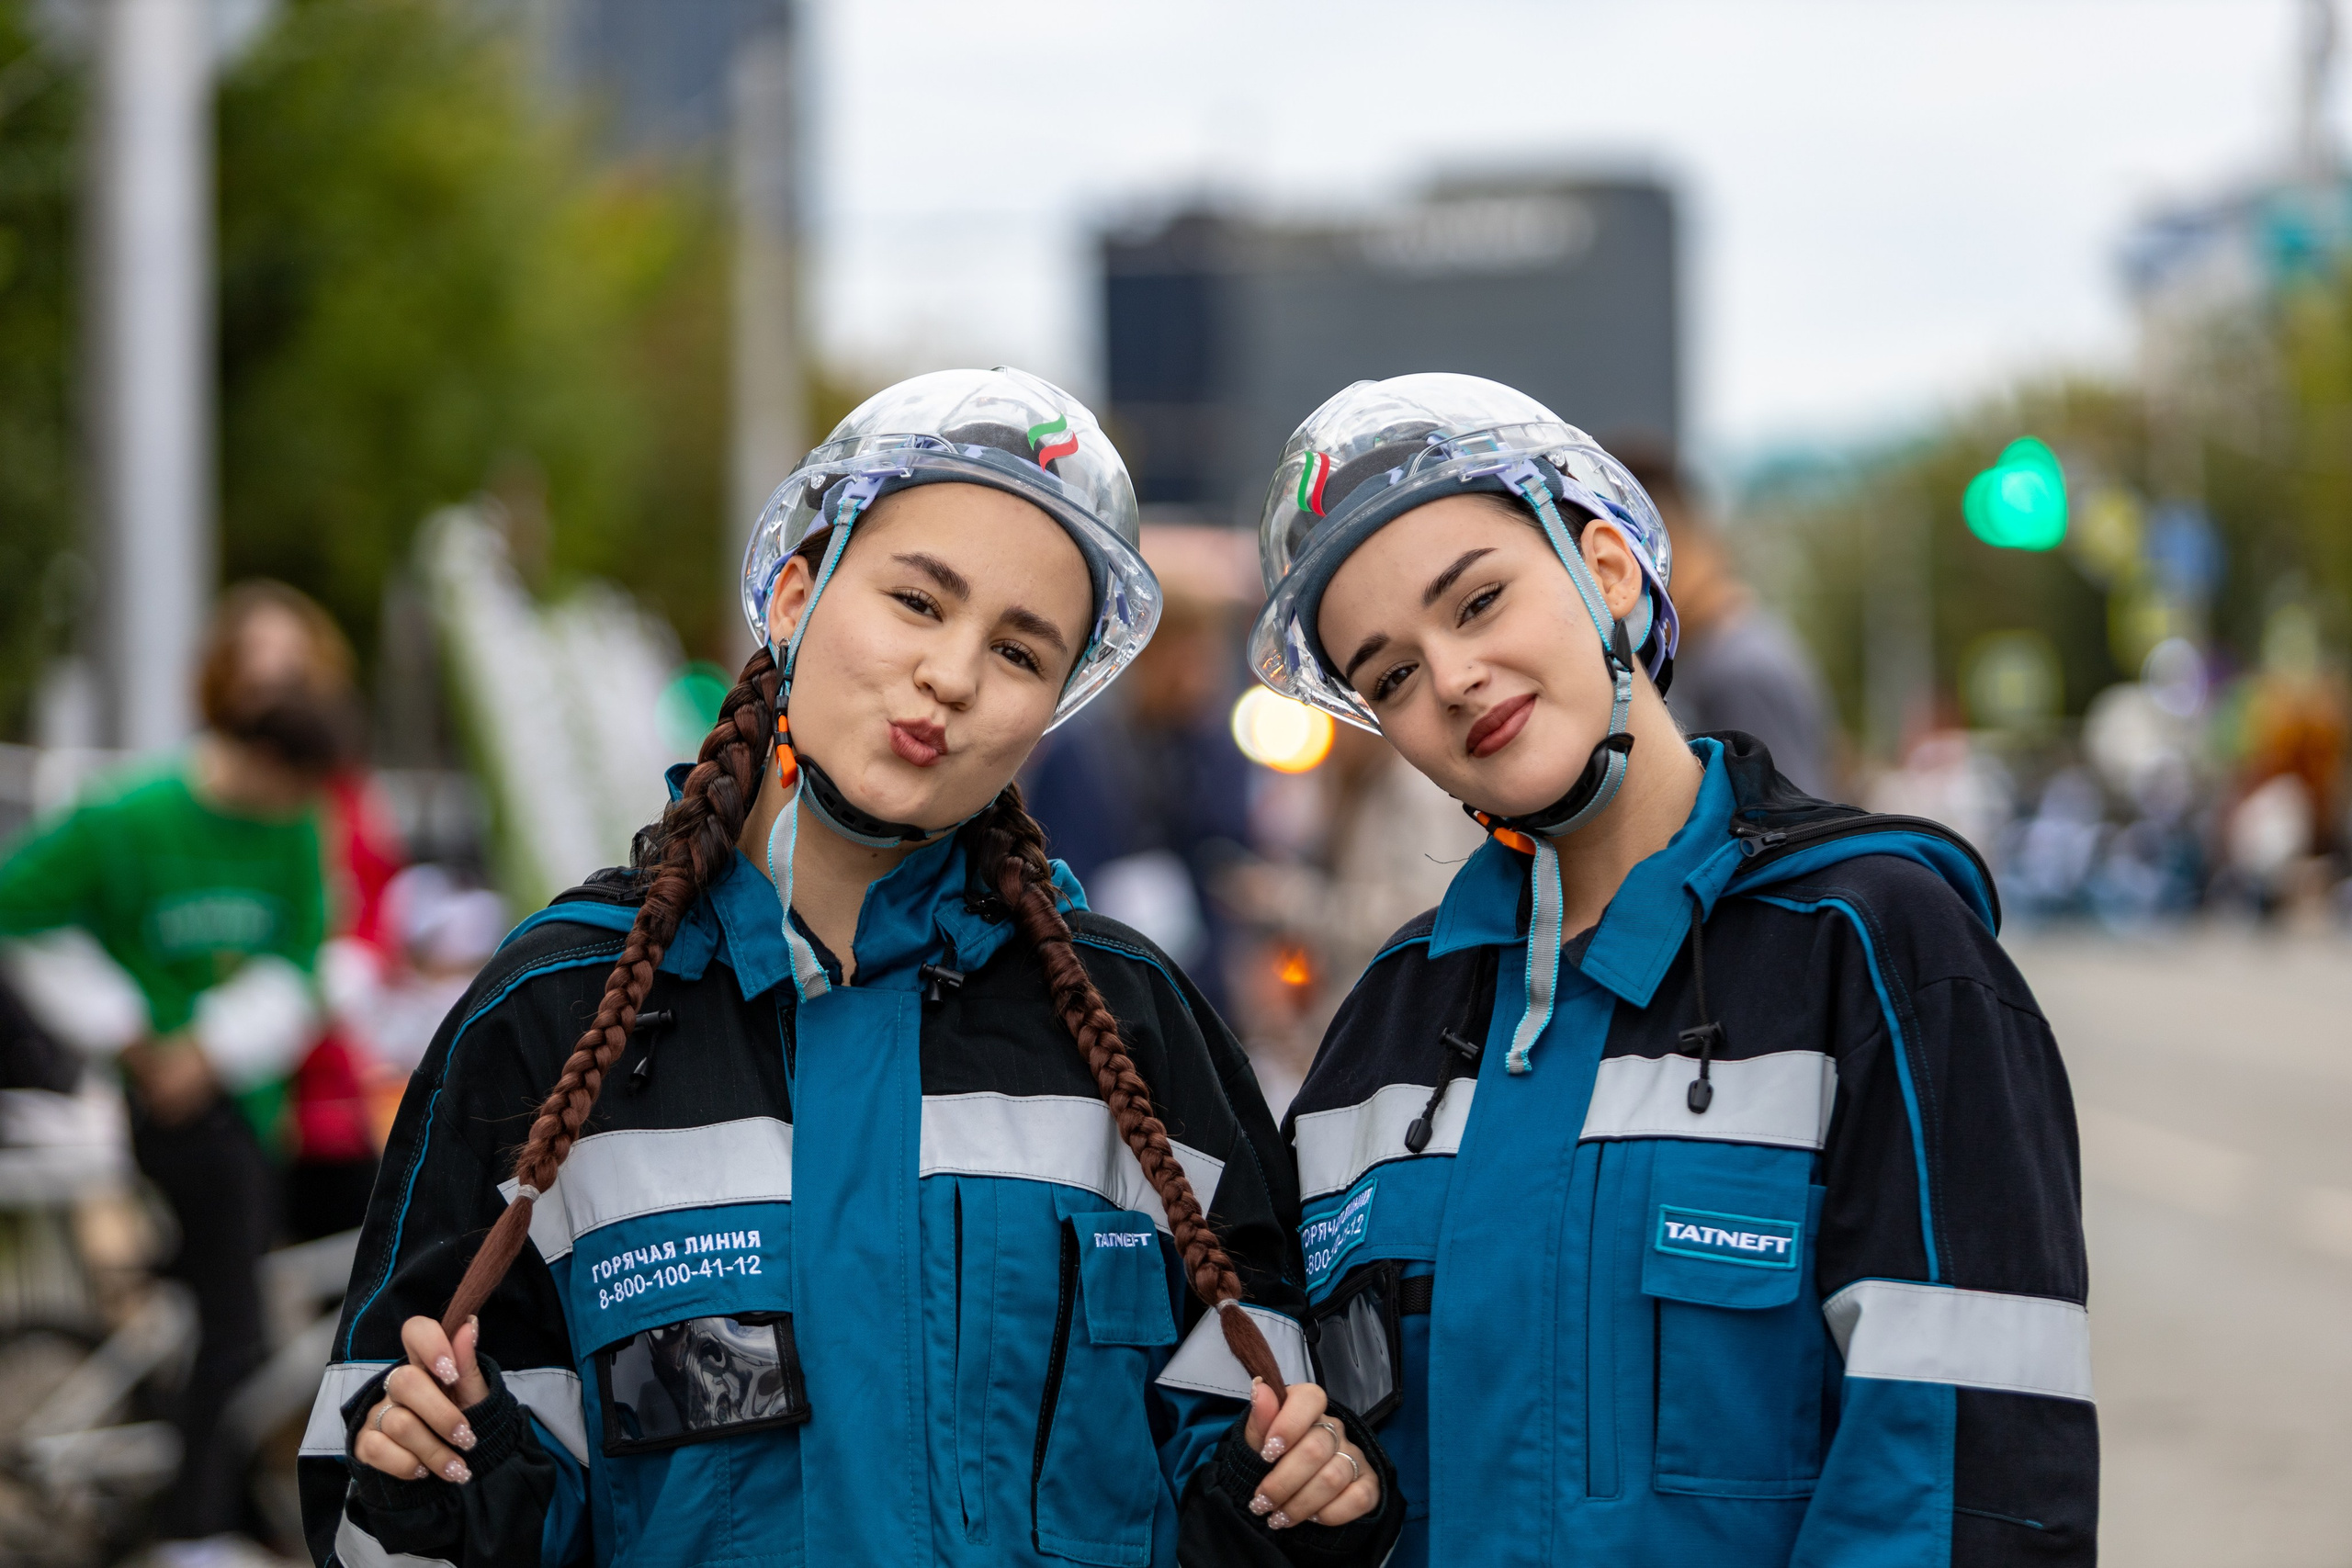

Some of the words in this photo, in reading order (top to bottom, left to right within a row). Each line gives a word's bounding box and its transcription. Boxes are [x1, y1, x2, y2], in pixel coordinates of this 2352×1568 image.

[591, 1241, 676, 1283] ГОРЯЧАЯ
[684, 1230, 761, 1255] ЛИНИЯ
[1093, 1233, 1152, 1247] TATNEFT
[1665, 1222, 1792, 1254] TATNEFT
[599, 1255, 763, 1310] 8-800-100-41-12
